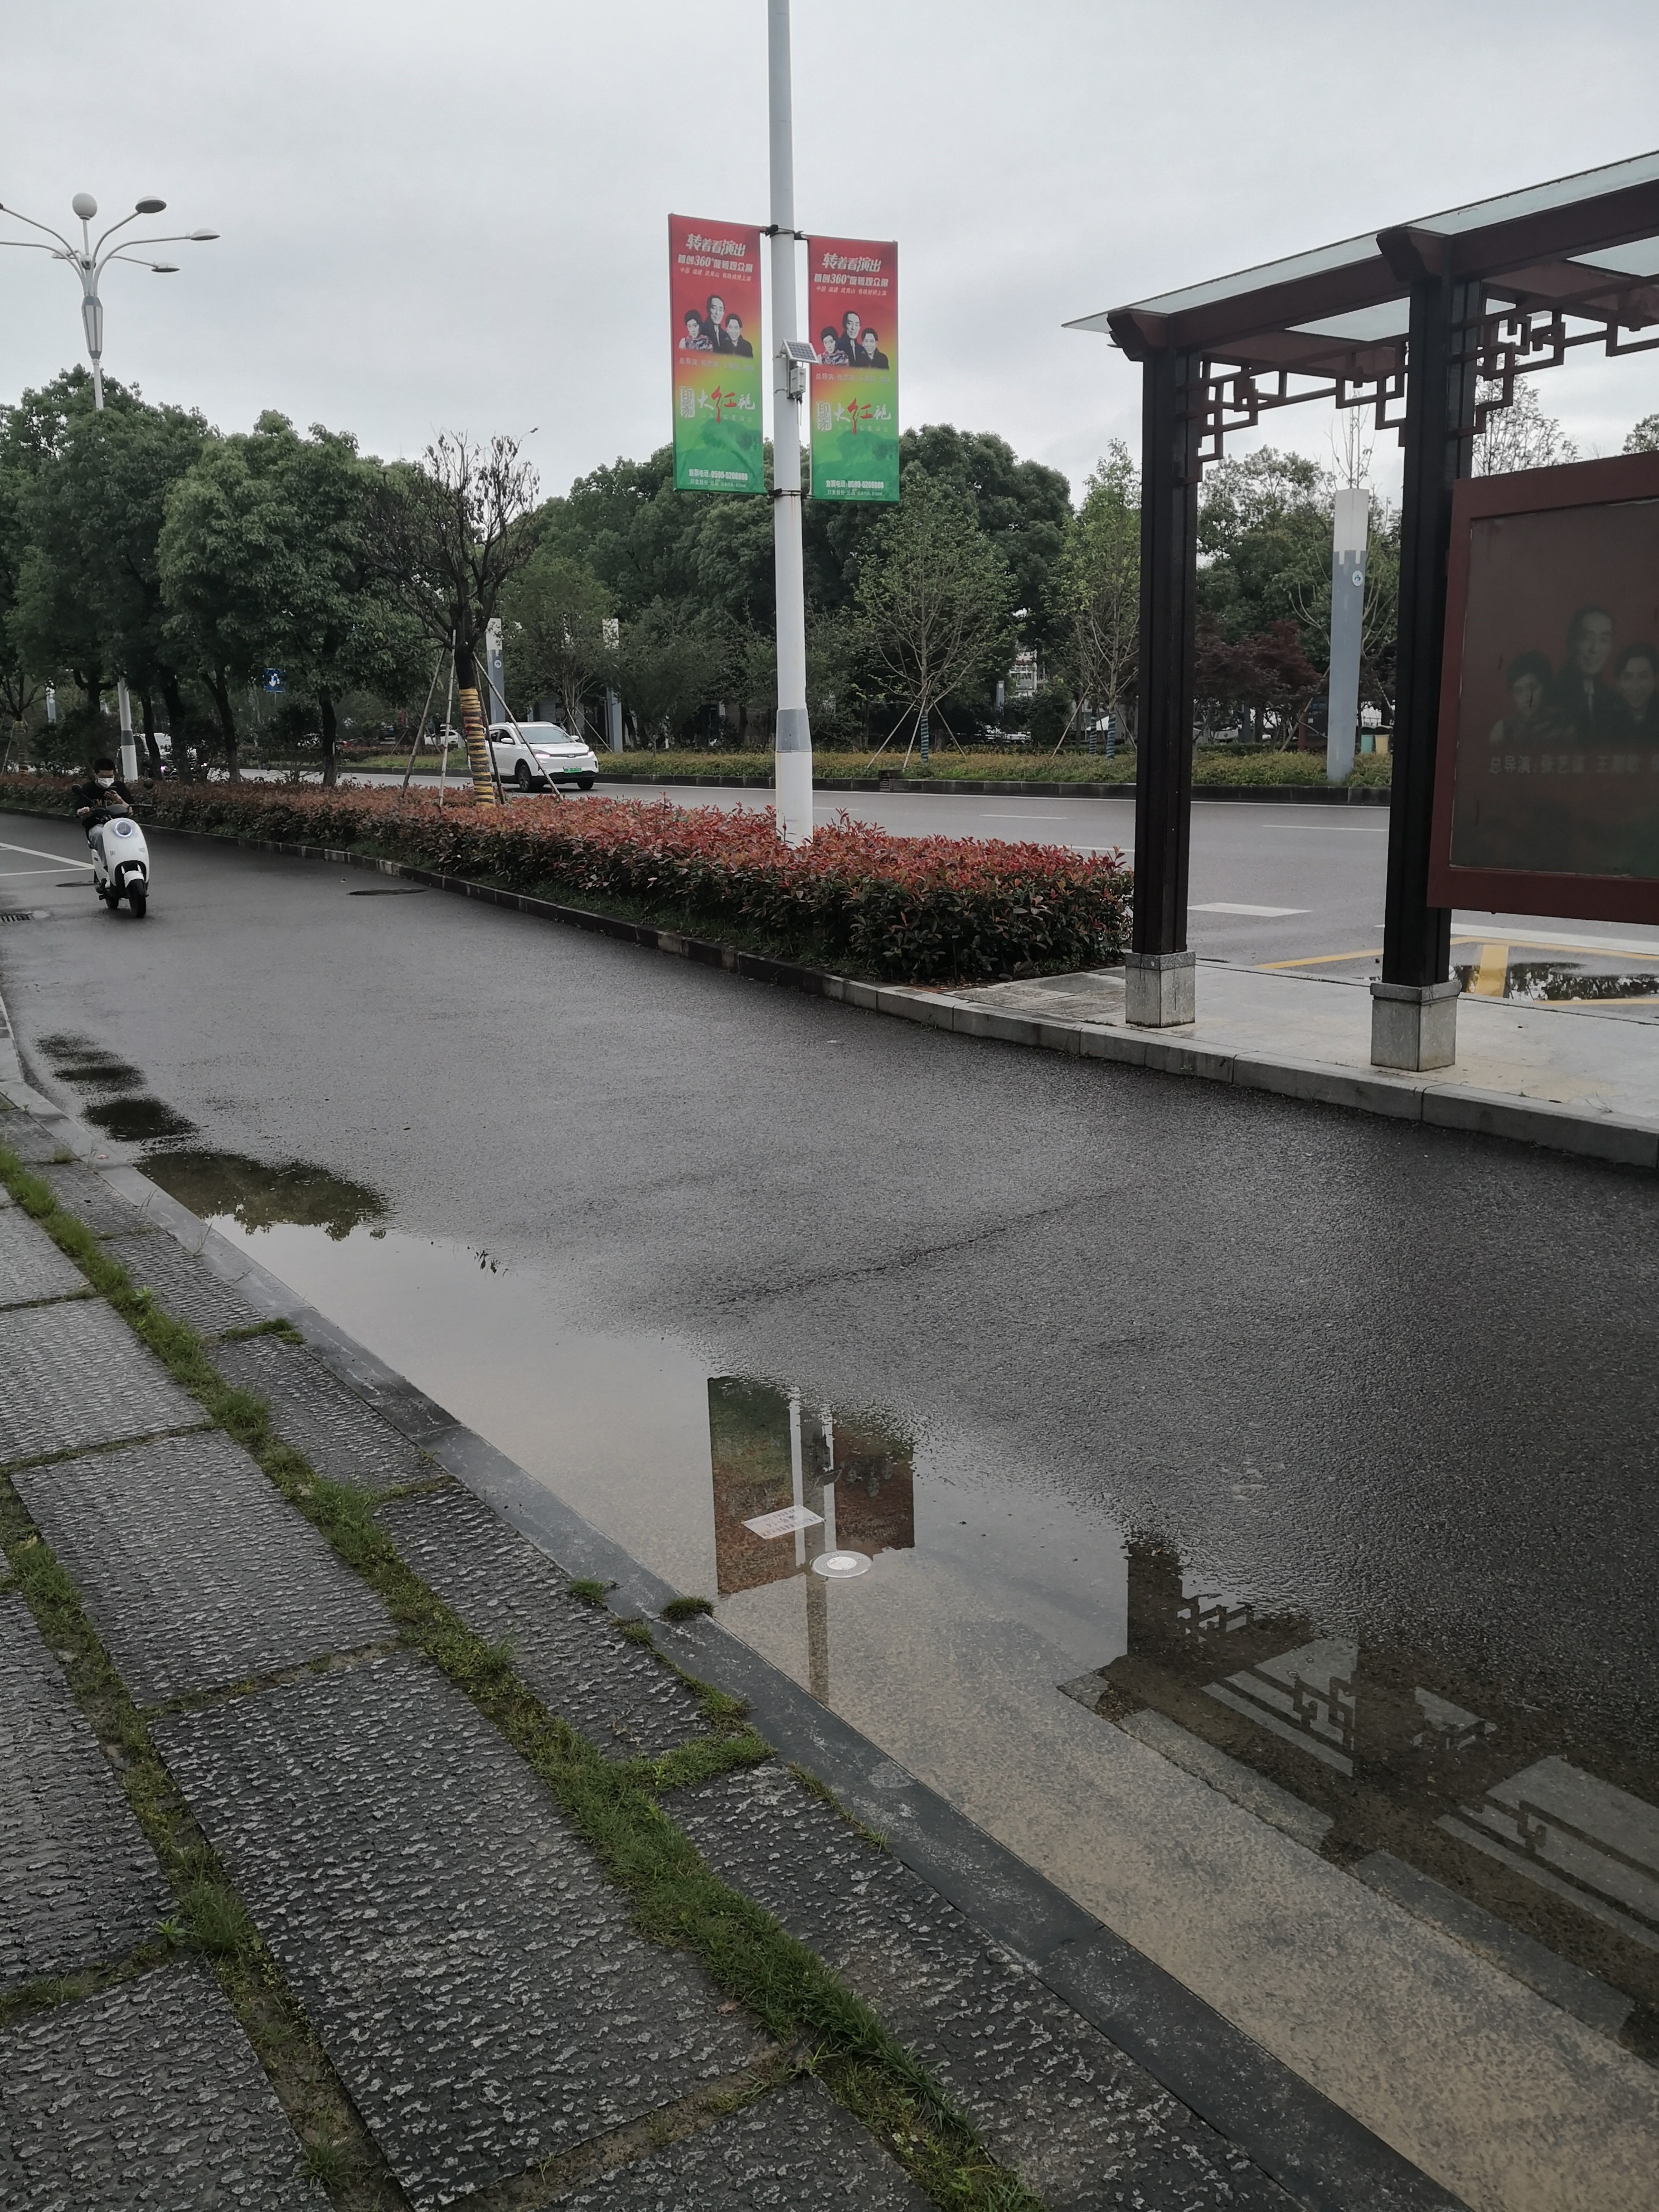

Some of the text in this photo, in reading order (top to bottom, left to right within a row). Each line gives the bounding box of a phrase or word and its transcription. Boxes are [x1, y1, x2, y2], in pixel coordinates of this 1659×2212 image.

[686, 233, 746, 256] 转着看演出
[677, 254, 753, 273] 首创360°旋转观众席
[822, 253, 881, 272] 转着看演出
[814, 273, 889, 287] 首创360°旋转观众席
